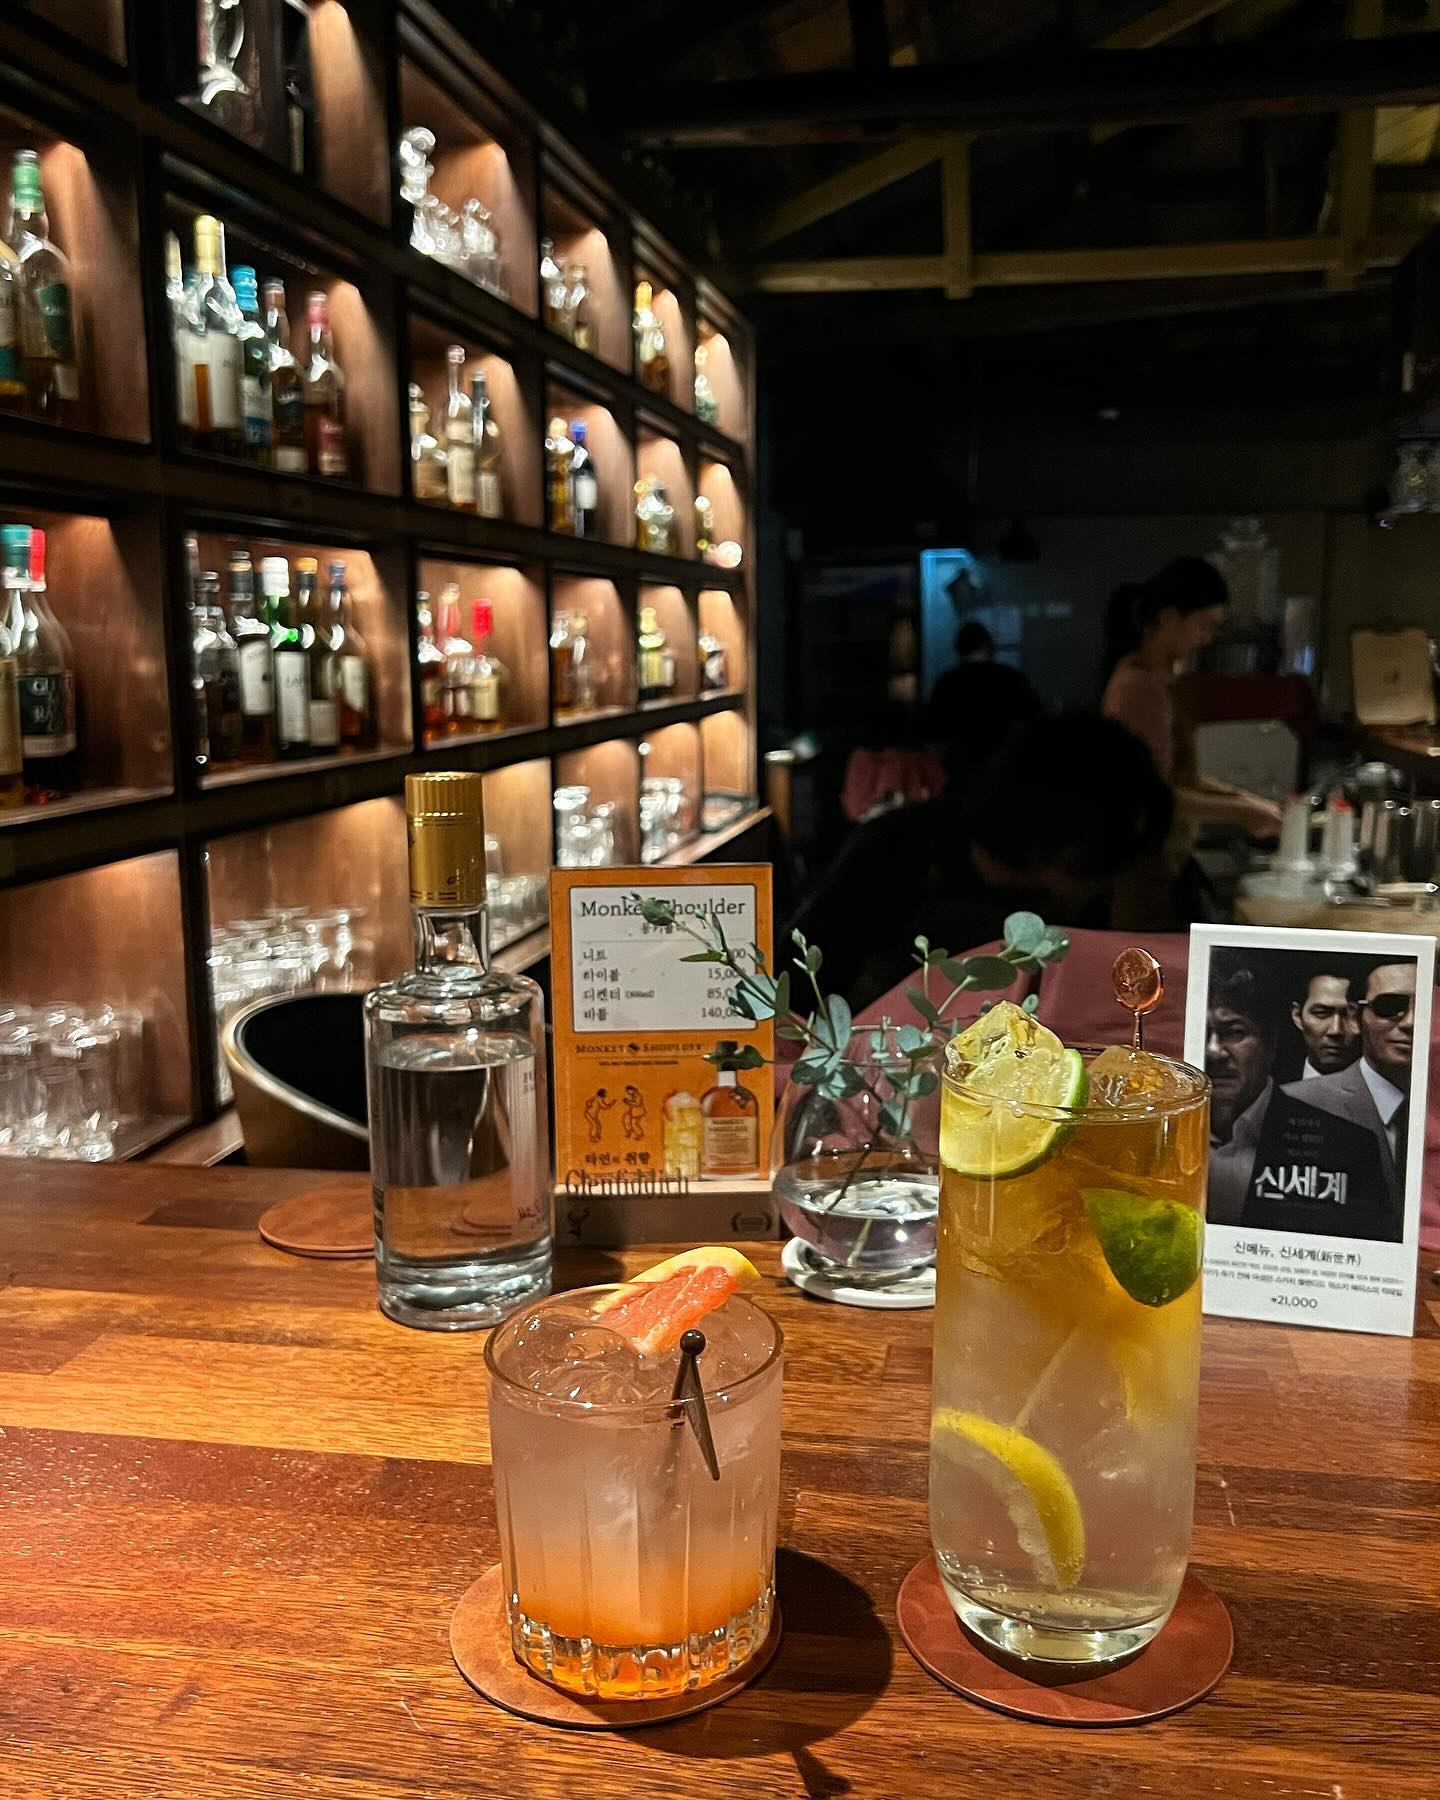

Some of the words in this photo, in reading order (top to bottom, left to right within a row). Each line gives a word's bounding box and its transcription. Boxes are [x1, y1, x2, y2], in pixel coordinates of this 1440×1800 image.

[581, 898, 643, 917] Monke
[671, 897, 746, 916] houlder
[1255, 1164, 1348, 1205] 신세계
